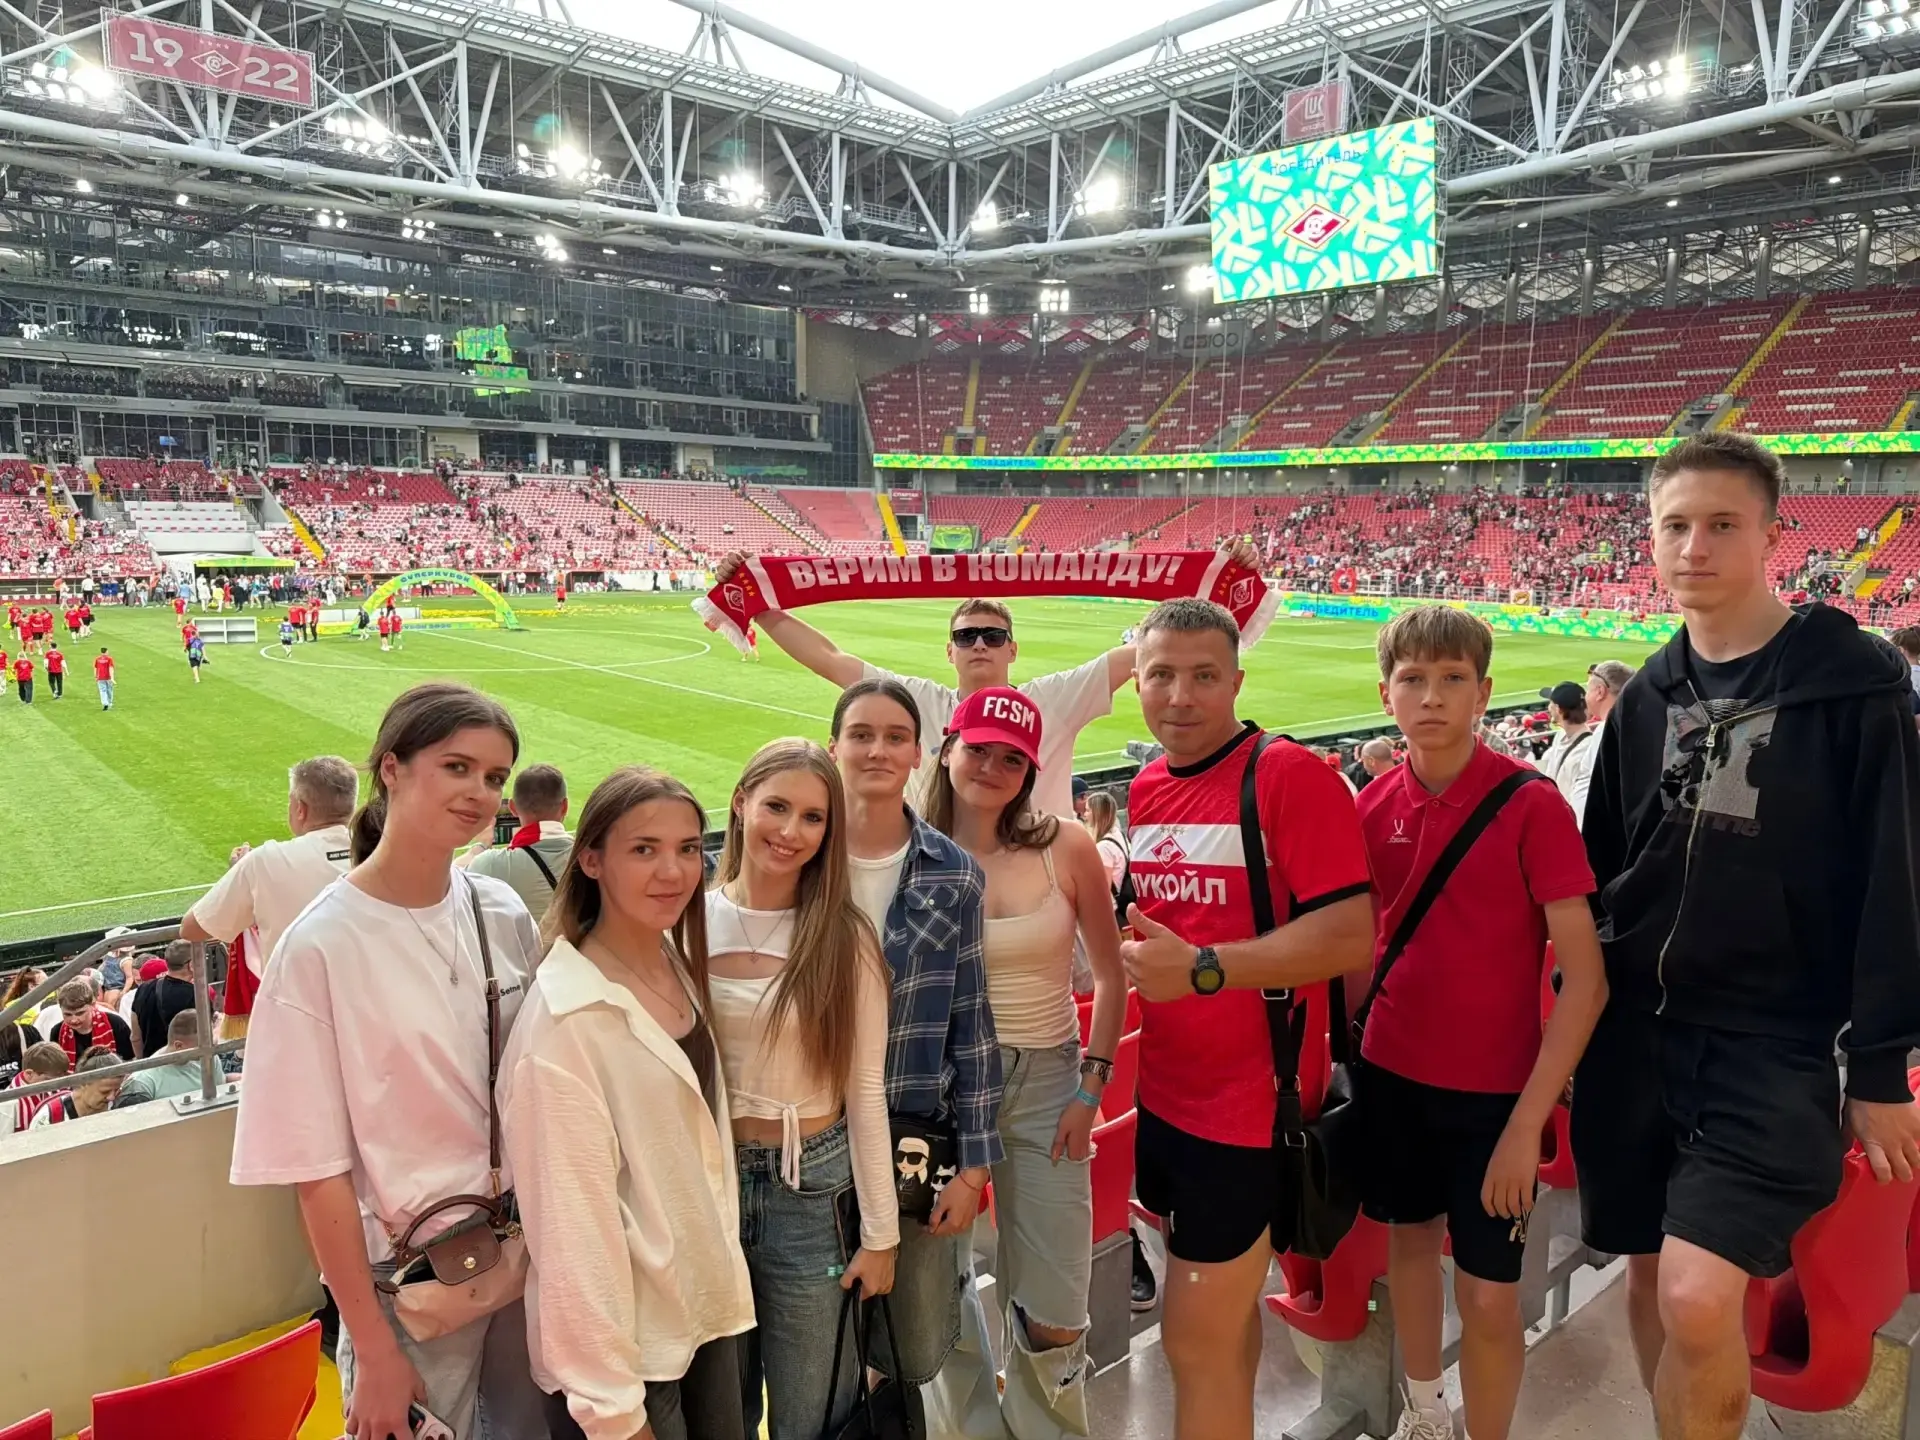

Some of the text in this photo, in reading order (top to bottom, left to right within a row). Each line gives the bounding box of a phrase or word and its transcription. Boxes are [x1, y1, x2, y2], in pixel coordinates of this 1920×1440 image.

[128, 31, 299, 93] 19 22
[1269, 149, 1362, 176] ПОБЕДИТЕЛЬ
[1505, 443, 1592, 456] ПОБЕДИТЕЛЬ
[785, 553, 1184, 590] ВЕРИМ В КОМАНДУ!
[1300, 603, 1379, 618] ПОБЕДИТЕЛЬ
[982, 696, 1036, 733] FCSM
